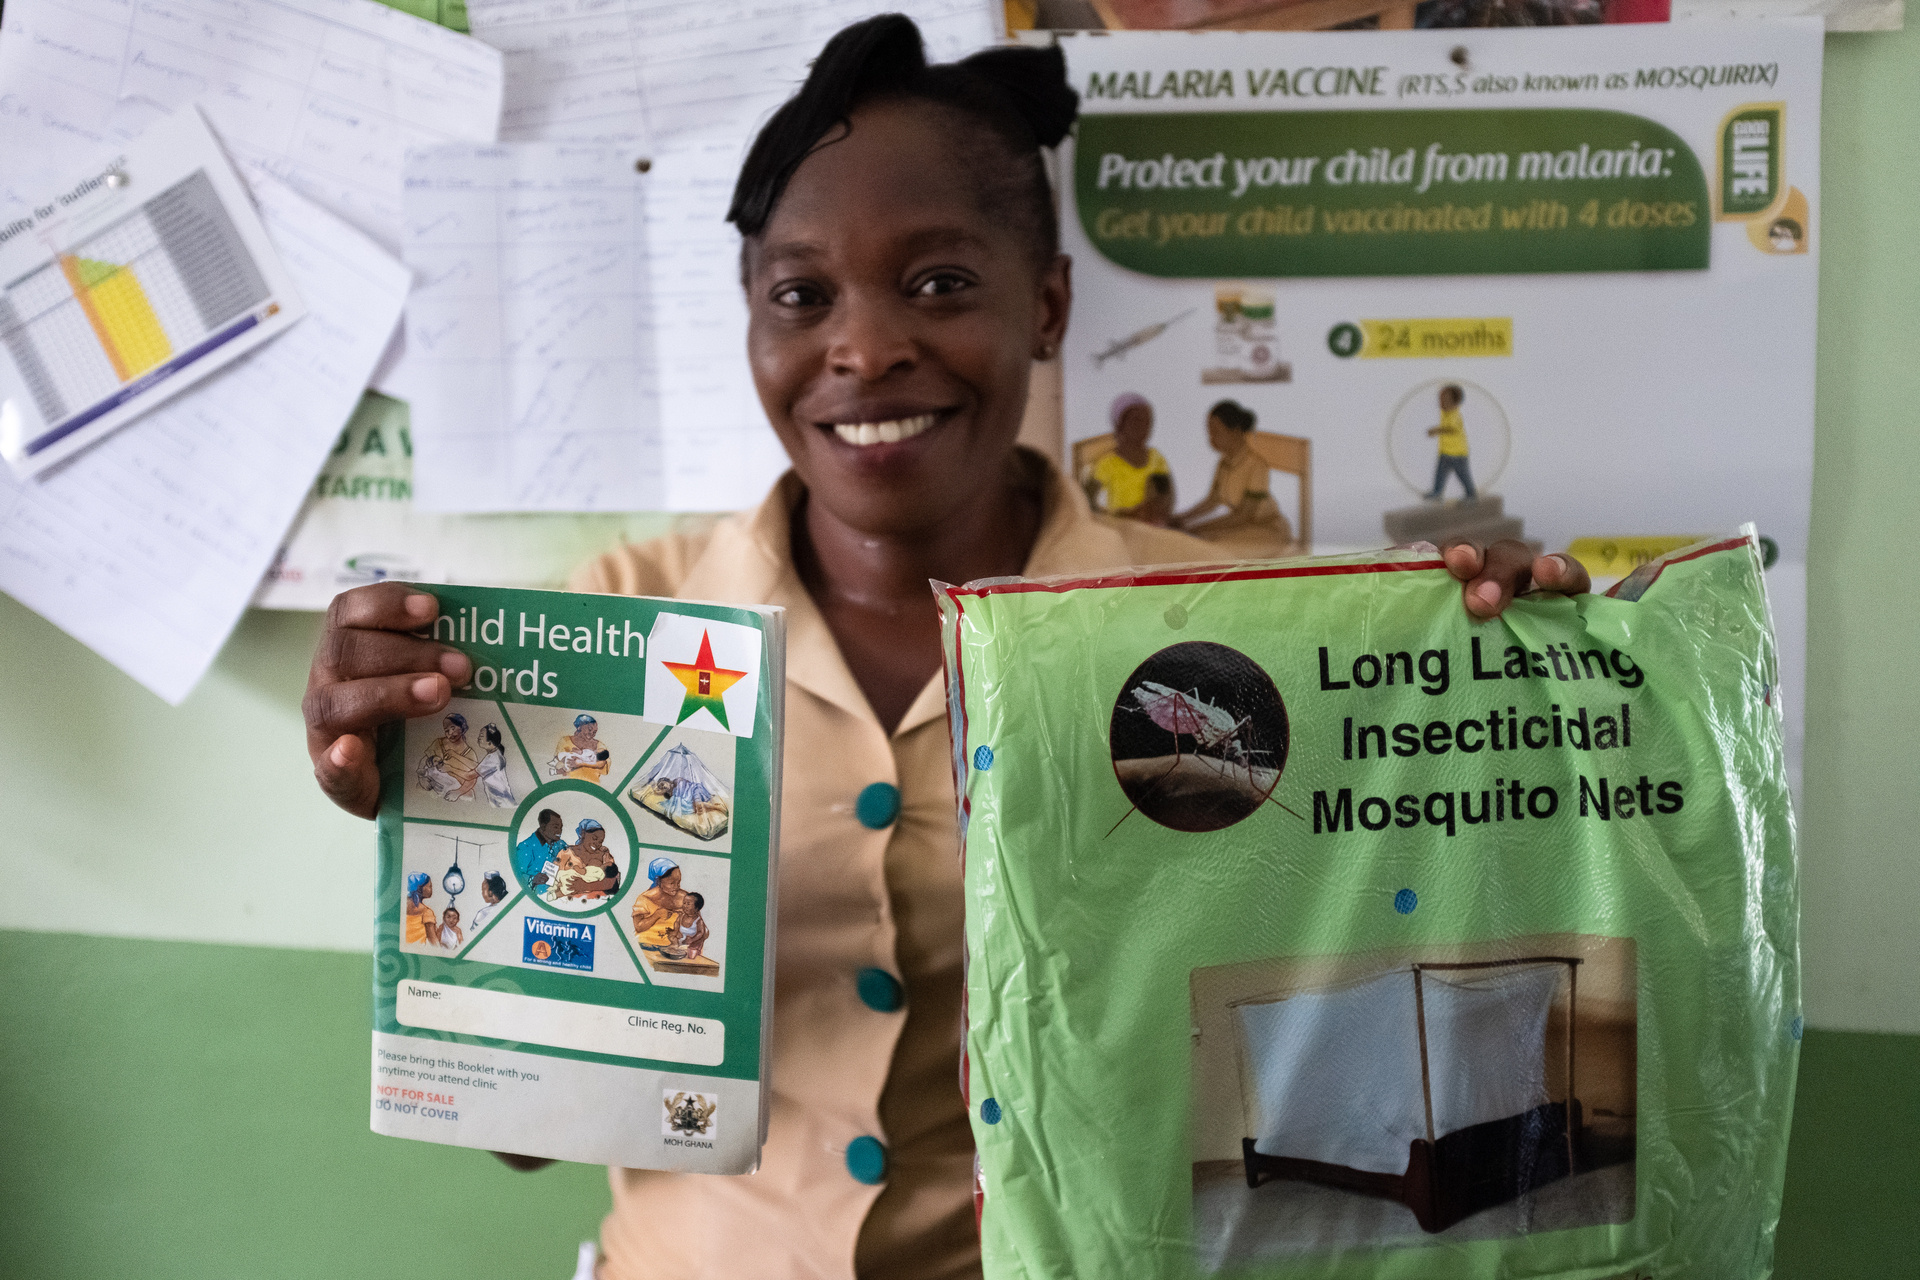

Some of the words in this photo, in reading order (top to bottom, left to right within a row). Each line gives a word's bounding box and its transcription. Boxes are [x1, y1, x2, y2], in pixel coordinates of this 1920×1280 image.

[1087, 69, 1235, 99] MALARIA
[1246, 66, 1389, 97] VACCINE
[1473, 71, 1518, 94] also
[1523, 70, 1599, 93] known
[1605, 72, 1629, 88] as
[1634, 62, 1778, 91] MOSQUIRIX)
[1097, 152, 1226, 189] Protect
[1231, 155, 1318, 198] your
[1324, 147, 1415, 184] child
[1416, 142, 1510, 193] from
[1518, 140, 1675, 180] malaria:
[1733, 136, 1769, 196] LIFE
[1097, 206, 1150, 239] Get
[1155, 211, 1226, 247] your
[1236, 204, 1315, 235] child
[1322, 200, 1493, 235] vaccinated
[1501, 199, 1569, 230] with
[1579, 199, 1599, 227] 4
[1607, 198, 1697, 227] doses
[1379, 323, 1411, 350] 24
[1422, 321, 1507, 349] months
[412, 606, 504, 646] hild
[519, 612, 645, 659] Health
[463, 659, 558, 698] ords
[1318, 645, 1450, 695] Long
[1471, 636, 1644, 688] Lasting
[1343, 703, 1631, 760] Insecticidal
[1312, 777, 1559, 836] Mosquito
[1579, 775, 1684, 821] Nets
[526, 918, 578, 939] Vitamin
[581, 925, 592, 940] A
[535, 942, 548, 957] A
[407, 985, 441, 1000] Name:
[627, 1015, 659, 1030] Clinic
[661, 1018, 685, 1034] Reg.
[687, 1023, 706, 1035] No.
[377, 1049, 407, 1063] Please
[409, 1053, 435, 1068] bring
[437, 1058, 455, 1070] this
[457, 1060, 495, 1075] Booklet
[497, 1067, 519, 1078] with
[521, 1072, 540, 1082] you
[377, 1065, 415, 1079] anytime
[417, 1071, 436, 1081] you
[438, 1073, 470, 1086] attend
[472, 1079, 498, 1090] clinic
[375, 1099, 391, 1111] DO
[394, 1103, 418, 1115] NOT
[420, 1106, 459, 1121] COVER
[377, 1085, 398, 1097] NOT
[402, 1089, 424, 1101] FOR
[427, 1092, 454, 1105] SALE
[664, 1138, 683, 1147] MOH
[684, 1140, 714, 1149] GHANA
